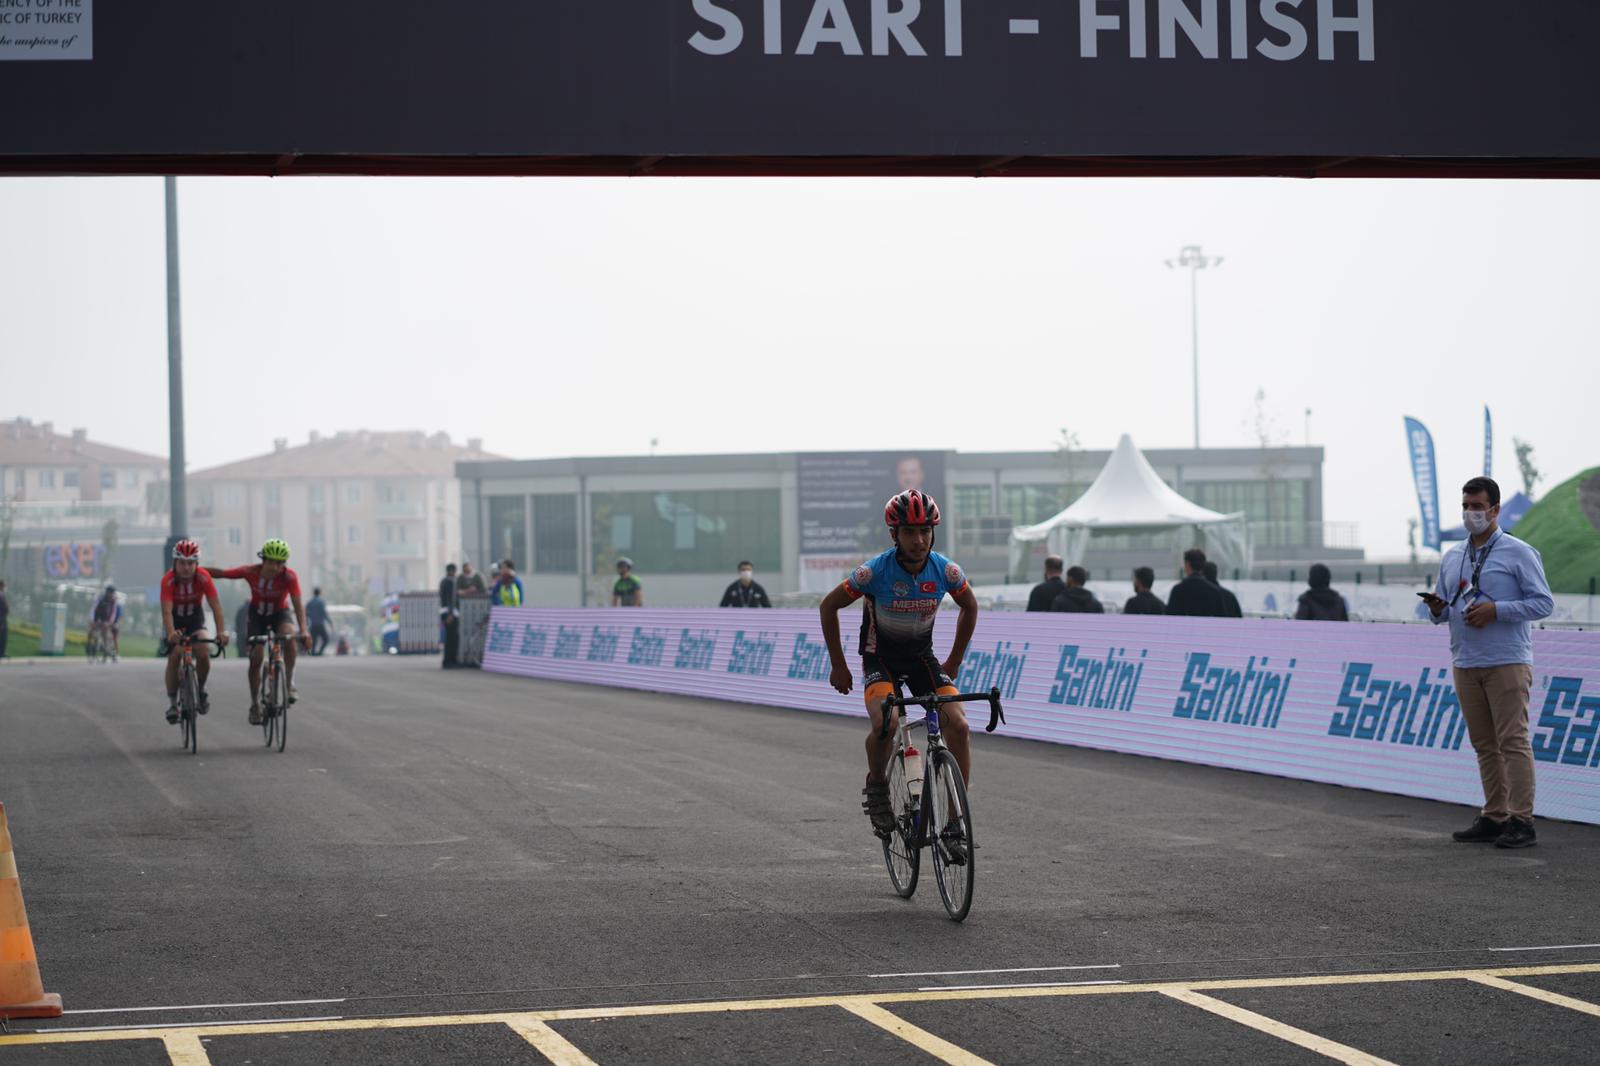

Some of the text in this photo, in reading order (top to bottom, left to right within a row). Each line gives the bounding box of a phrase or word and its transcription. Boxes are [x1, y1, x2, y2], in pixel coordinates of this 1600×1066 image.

[15, 12, 32, 24] OF
[34, 12, 82, 24] TURKEY
[687, 0, 963, 56] START
[1079, 0, 1375, 61] FINISH
[61, 34, 79, 49] of
[1048, 644, 1148, 712] Santini
[1172, 652, 1297, 728] Santini
[1328, 662, 1468, 751] Santin
